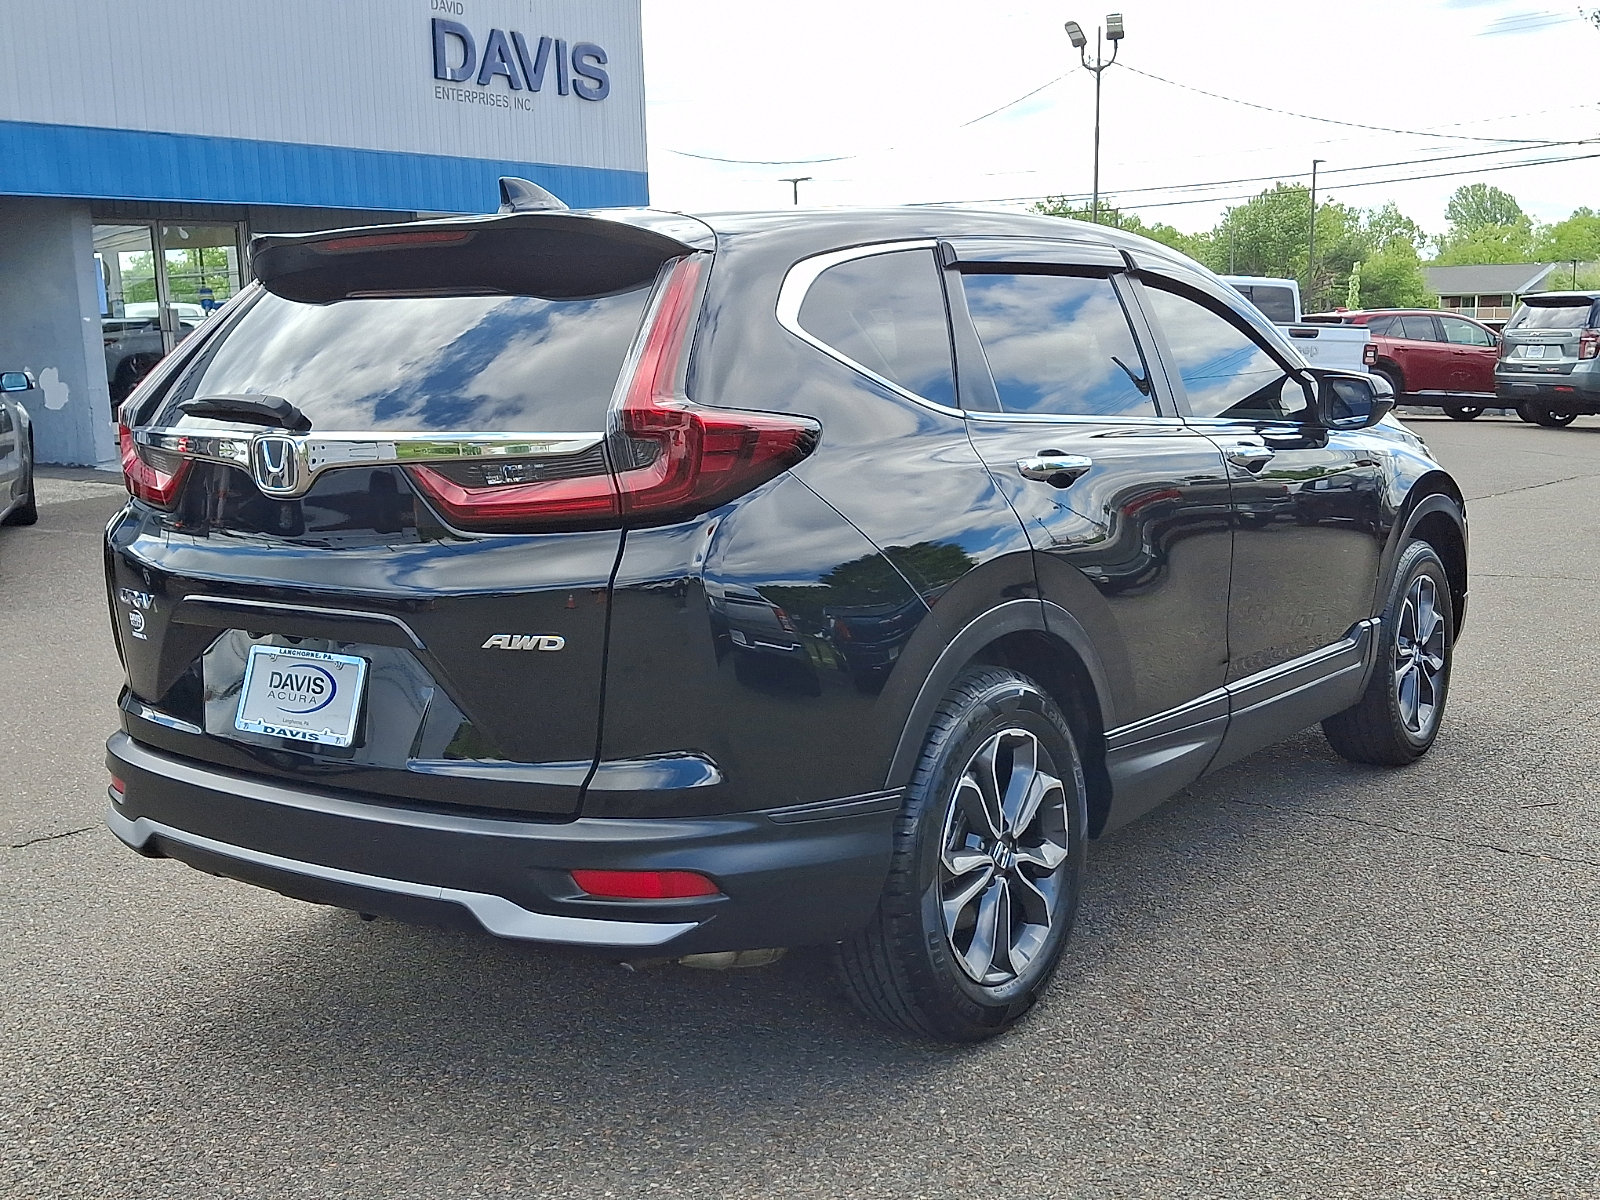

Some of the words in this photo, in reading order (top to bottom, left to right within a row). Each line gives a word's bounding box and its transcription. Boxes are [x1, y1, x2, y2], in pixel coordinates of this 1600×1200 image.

[431, 0, 464, 15] DAVID
[431, 18, 610, 102] DAVIS
[434, 85, 512, 111] ENTERPRISES,
[514, 96, 534, 112] INC.
[481, 634, 565, 651] AWD
[268, 671, 325, 695] DAVIS
[267, 690, 318, 705] ACURA
[263, 725, 320, 741] DAVIS
